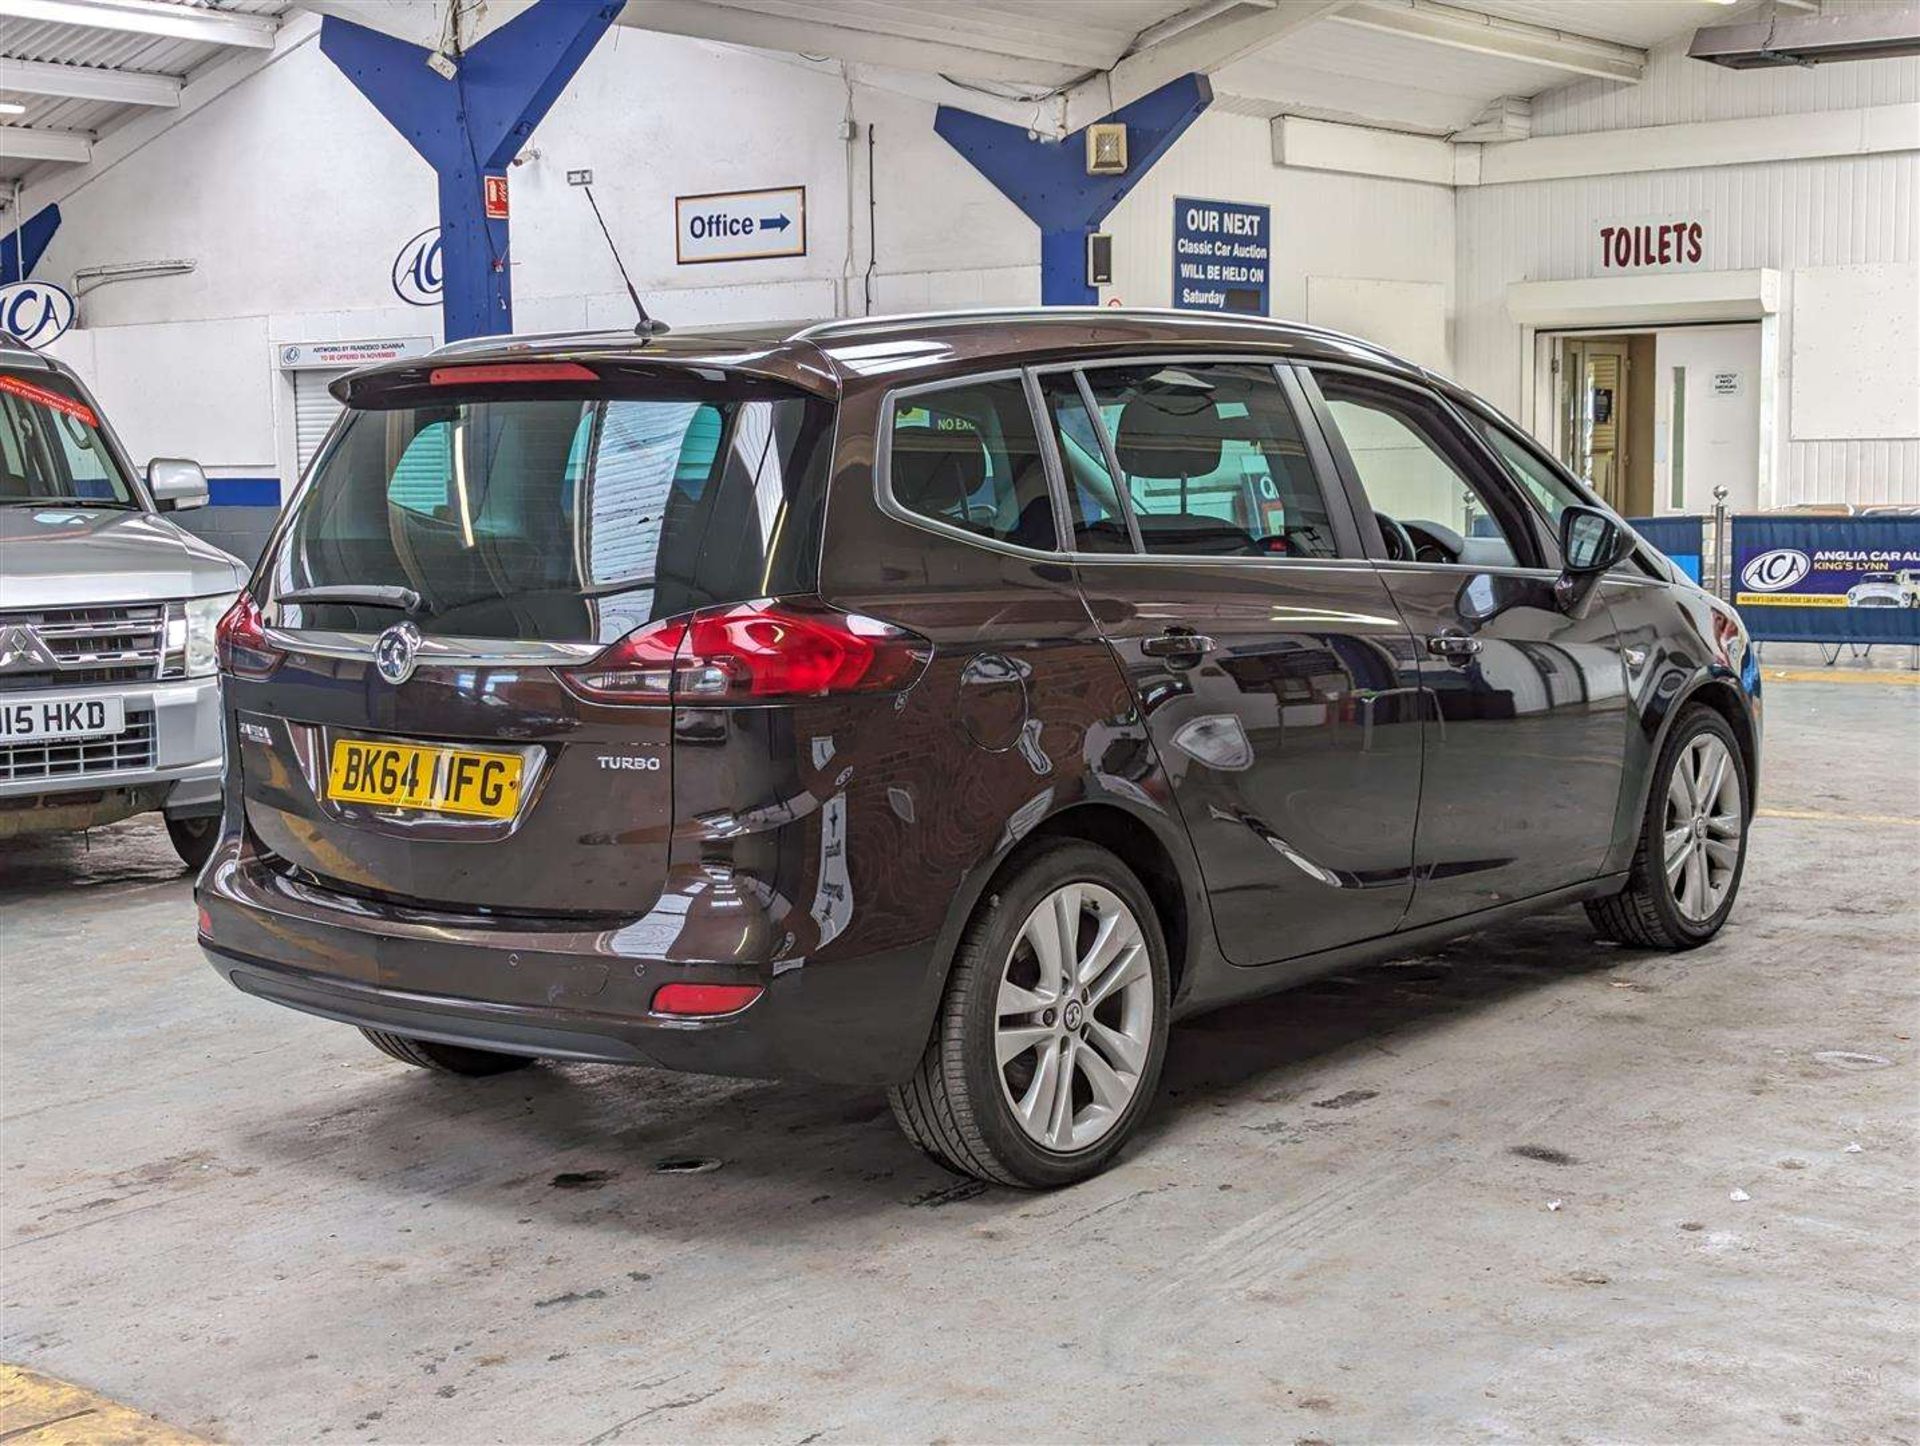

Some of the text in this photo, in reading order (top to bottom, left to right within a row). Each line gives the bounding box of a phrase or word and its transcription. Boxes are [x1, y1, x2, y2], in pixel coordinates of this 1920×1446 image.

[690, 213, 754, 239] Office
[1186, 208, 1261, 236] OUR NEXT
[1177, 238, 1267, 259] Classic Car Auction
[1600, 222, 1703, 268] TOILETS
[1180, 263, 1264, 283] WILL BE HELD ON
[1183, 288, 1226, 308] Saturday
[938, 418, 954, 430] NO
[1813, 561, 1889, 571] KING'S LYNN
[1814, 551, 1868, 561] ANGLIA
[1869, 551, 1900, 561] CAR
[1747, 554, 1801, 585] ACA
[0, 701, 105, 734] 15 HKD
[342, 747, 420, 798] BK64
[597, 756, 660, 771] TURBO
